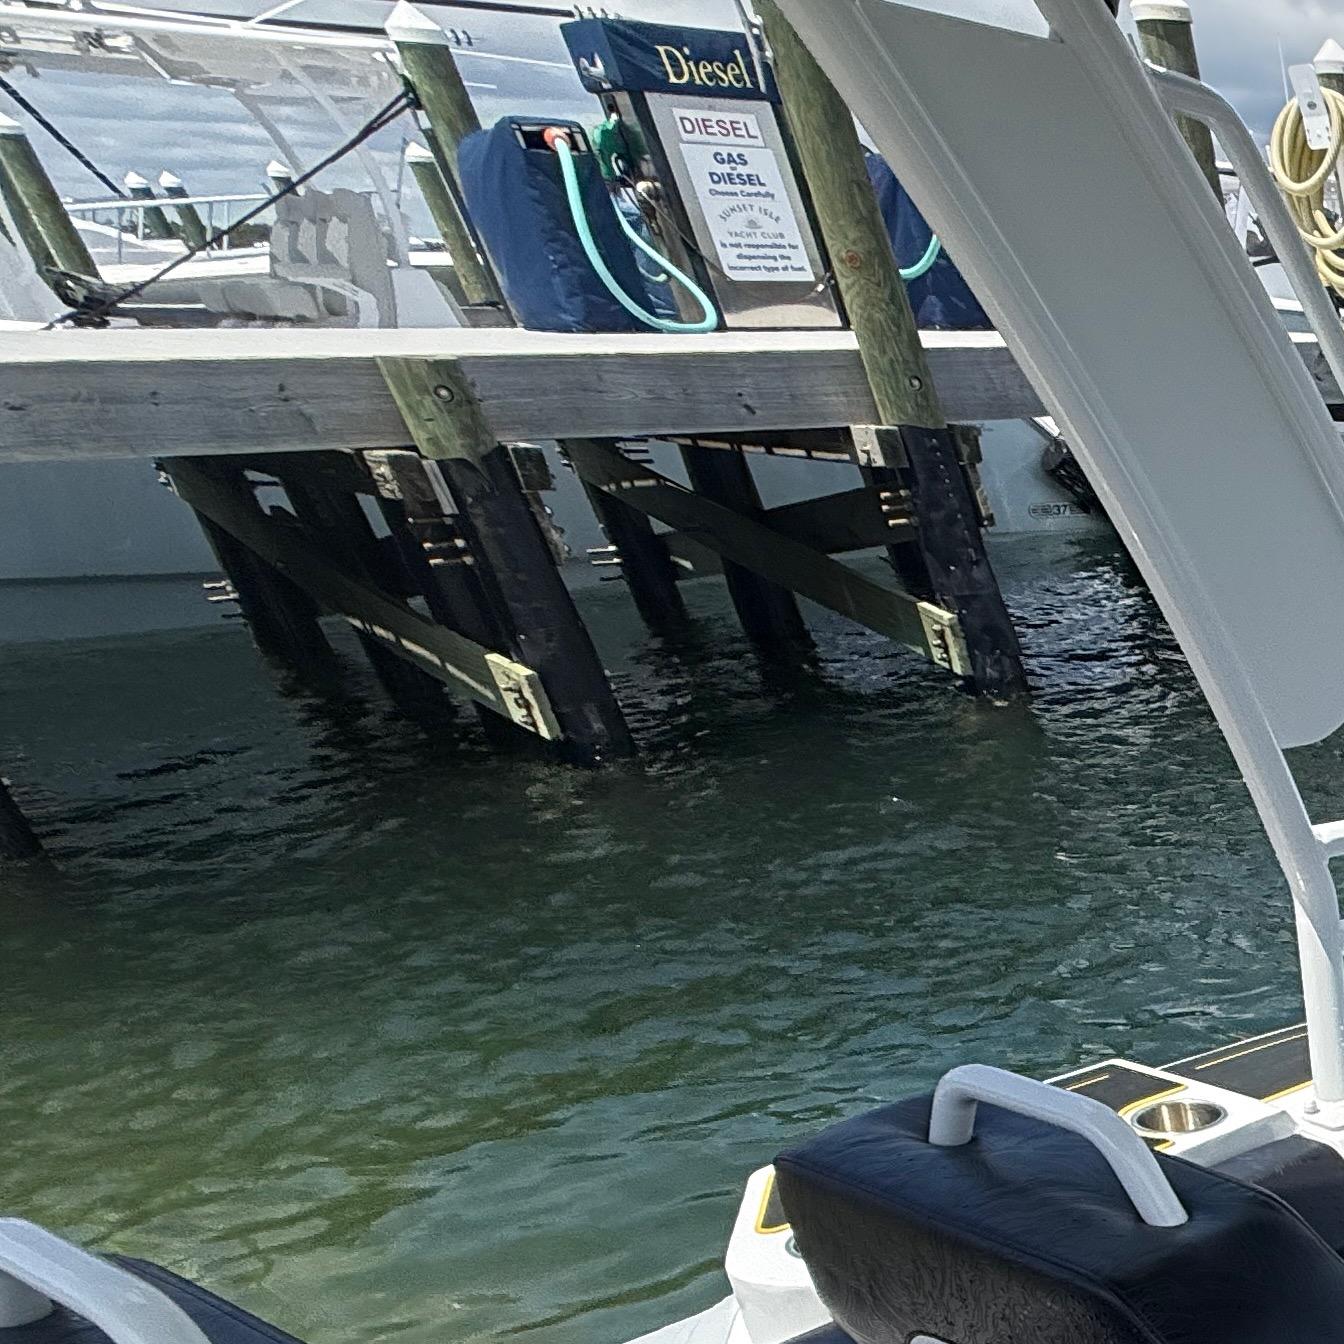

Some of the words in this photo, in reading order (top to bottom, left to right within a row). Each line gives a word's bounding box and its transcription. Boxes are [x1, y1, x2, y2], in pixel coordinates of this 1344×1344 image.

[654, 45, 754, 89] Diesel
[679, 117, 759, 139] DIESEL
[713, 151, 748, 166] GAS
[708, 172, 766, 187] DIESEL
[709, 188, 739, 197] Choose
[740, 190, 775, 200] Carefully
[719, 204, 754, 222] SUNSET
[758, 206, 781, 224] ISLE
[727, 231, 758, 239] YACHT
[761, 231, 785, 239] CLUB
